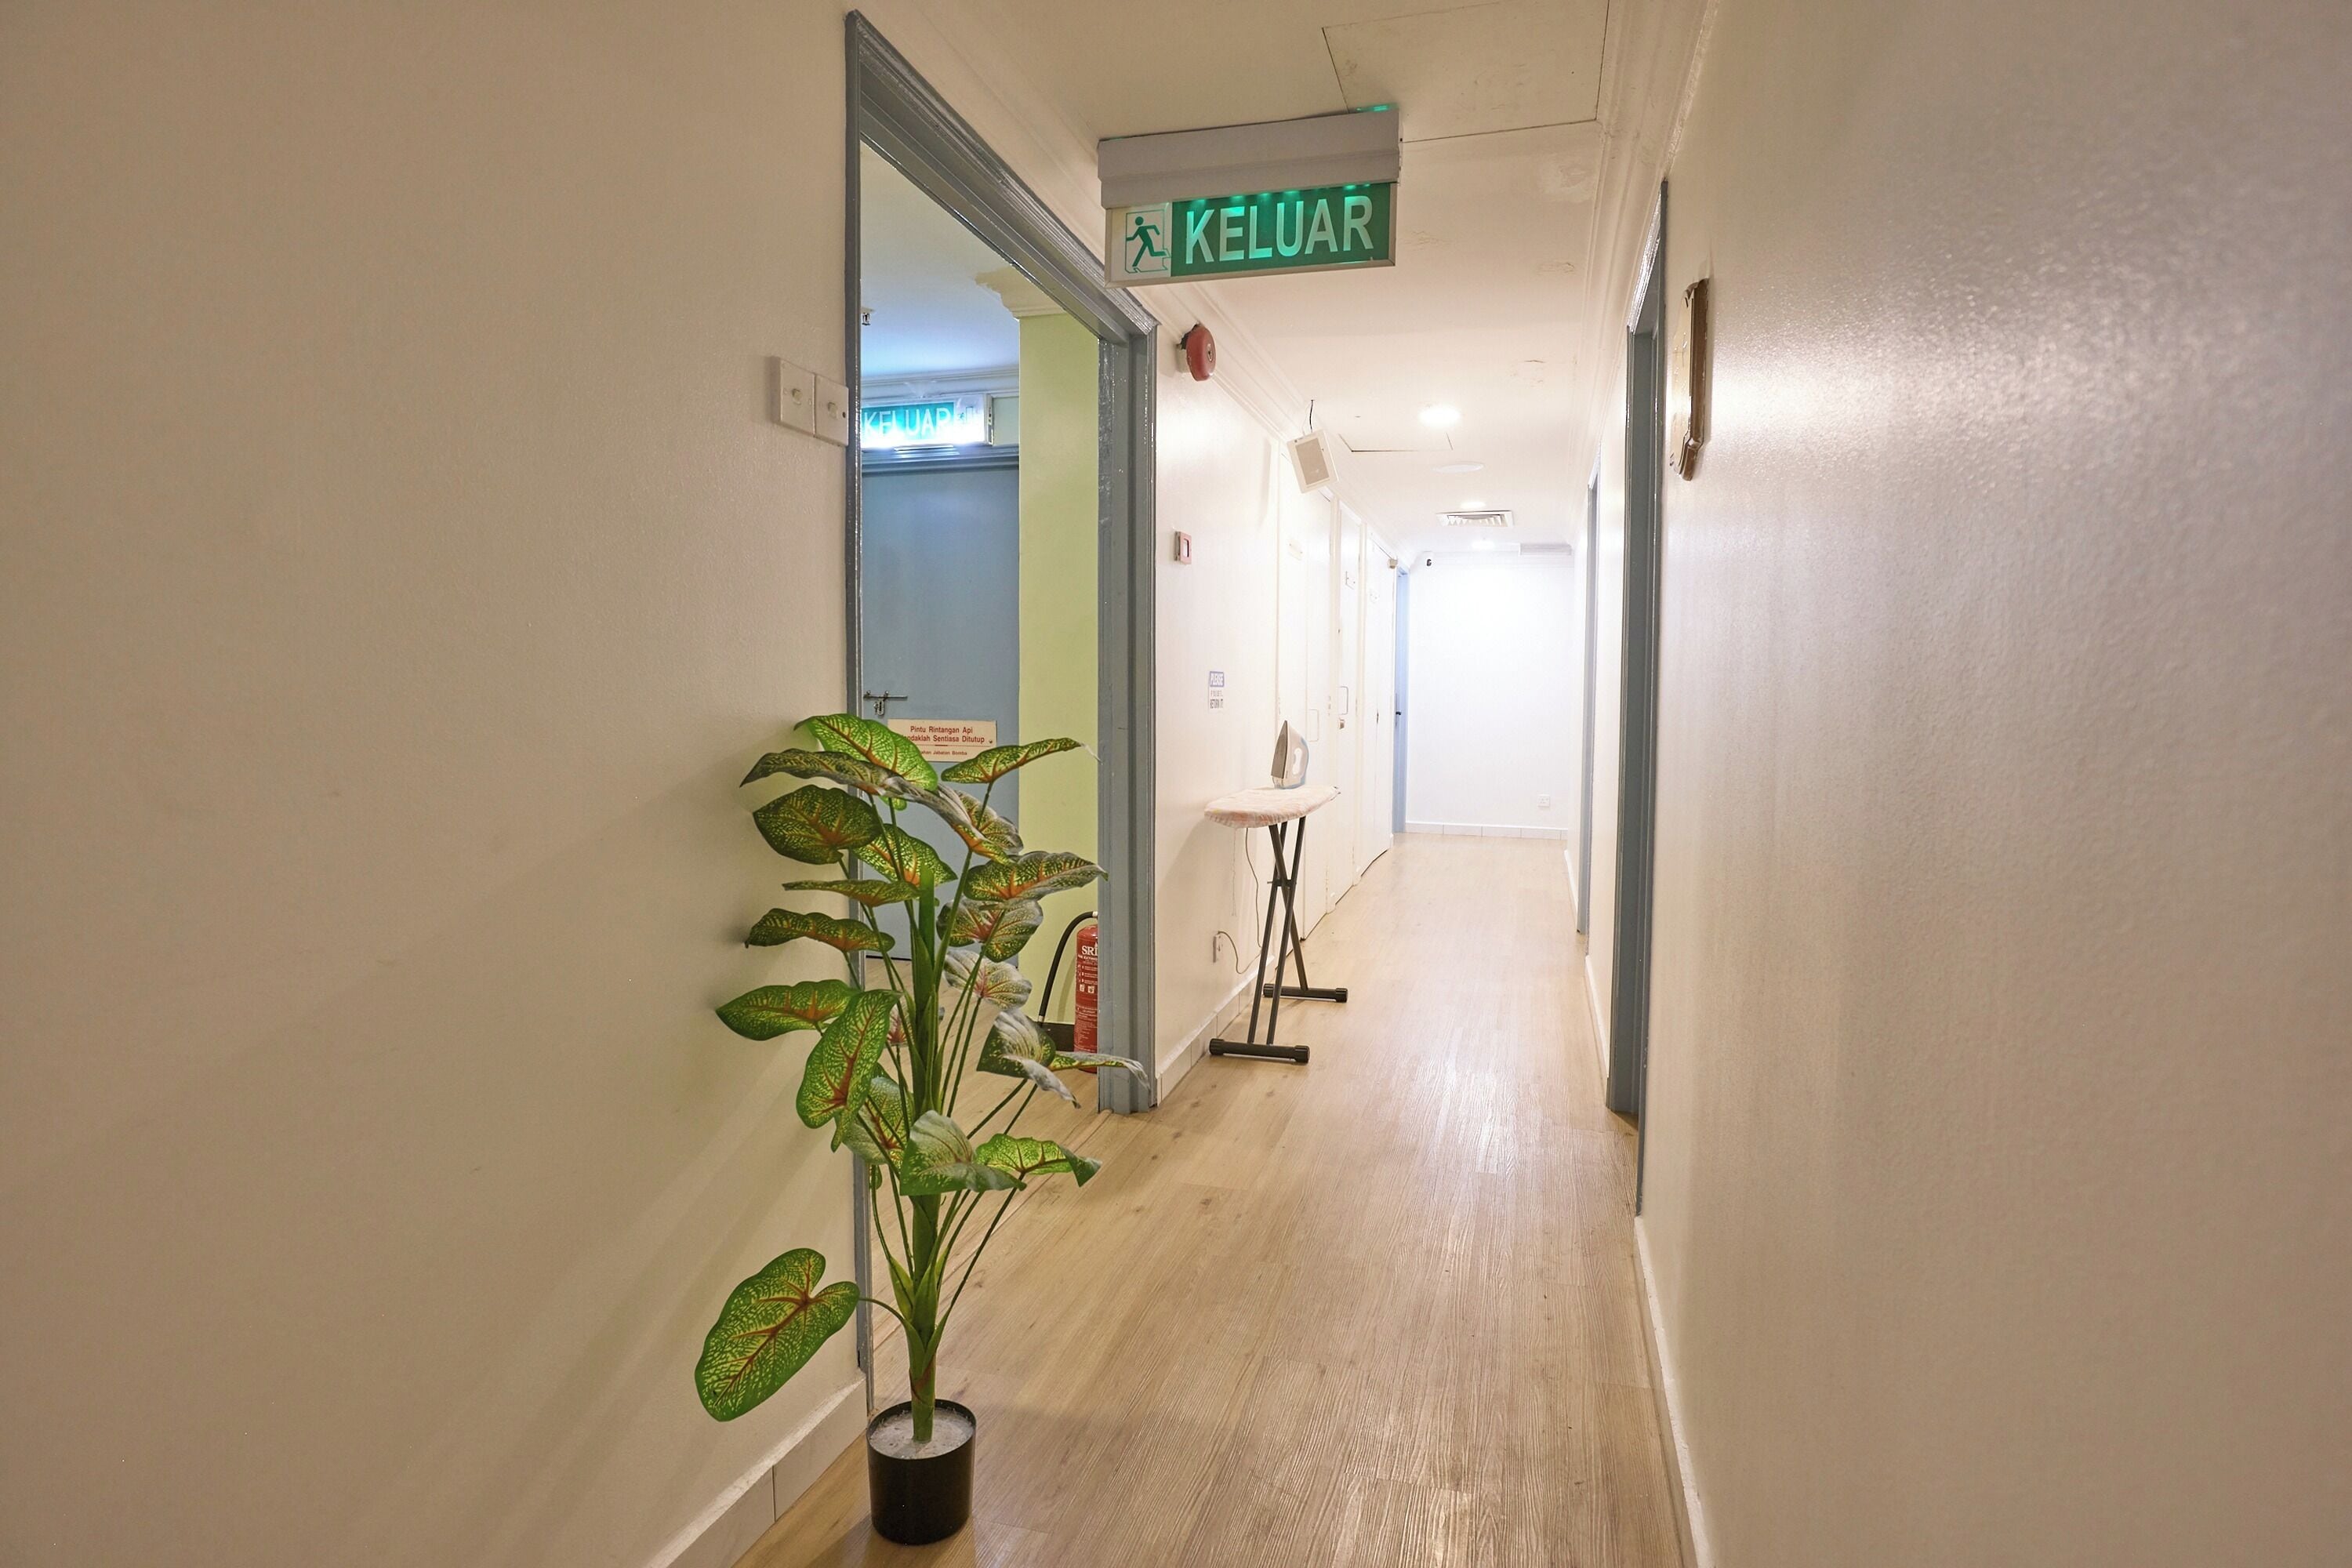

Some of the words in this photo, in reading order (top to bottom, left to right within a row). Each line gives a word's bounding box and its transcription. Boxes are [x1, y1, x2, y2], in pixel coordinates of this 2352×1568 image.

[1185, 195, 1374, 264] KELUAR
[928, 726, 960, 735] Rintangan
[962, 727, 973, 735] Api
[962, 735, 985, 744] Ditutup
